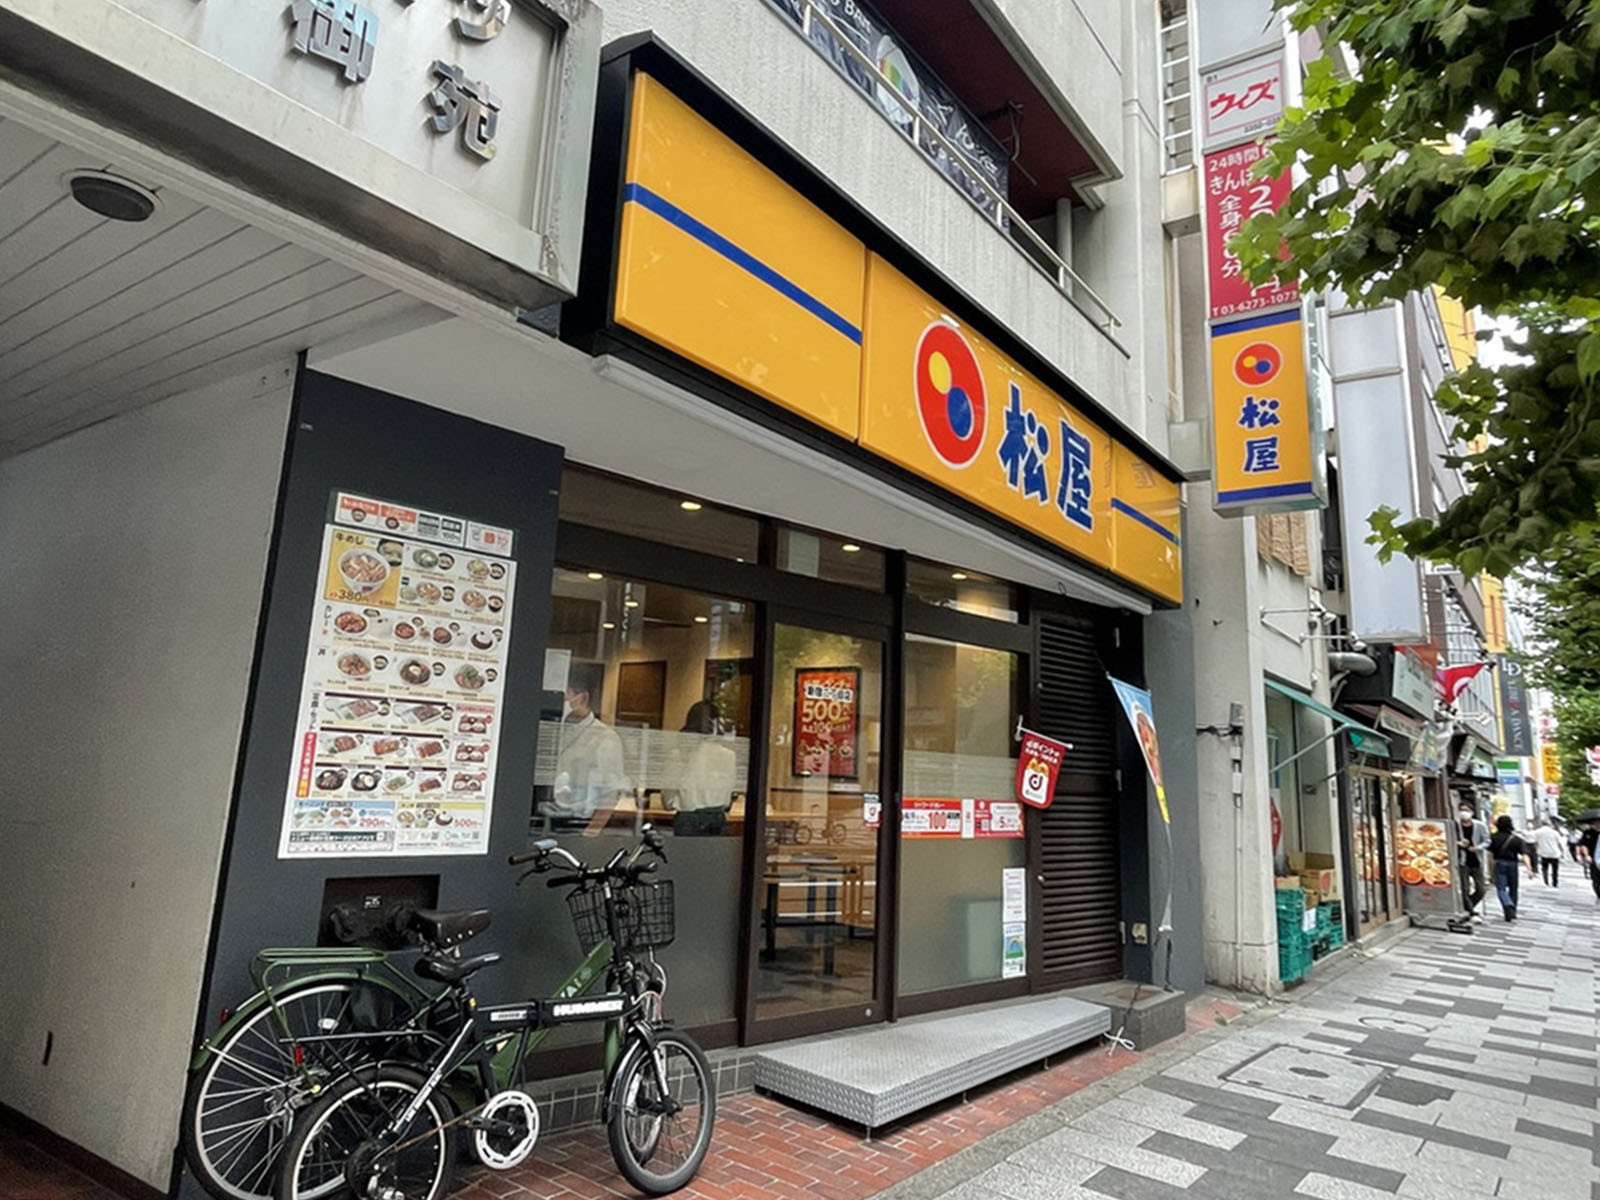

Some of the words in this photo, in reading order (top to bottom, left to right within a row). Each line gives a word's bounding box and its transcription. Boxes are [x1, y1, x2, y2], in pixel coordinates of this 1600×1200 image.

[1209, 77, 1279, 120] ウィズ
[1209, 139, 1280, 172] 24時間
[997, 381, 1095, 533] 松屋
[1238, 395, 1281, 474] 松屋
